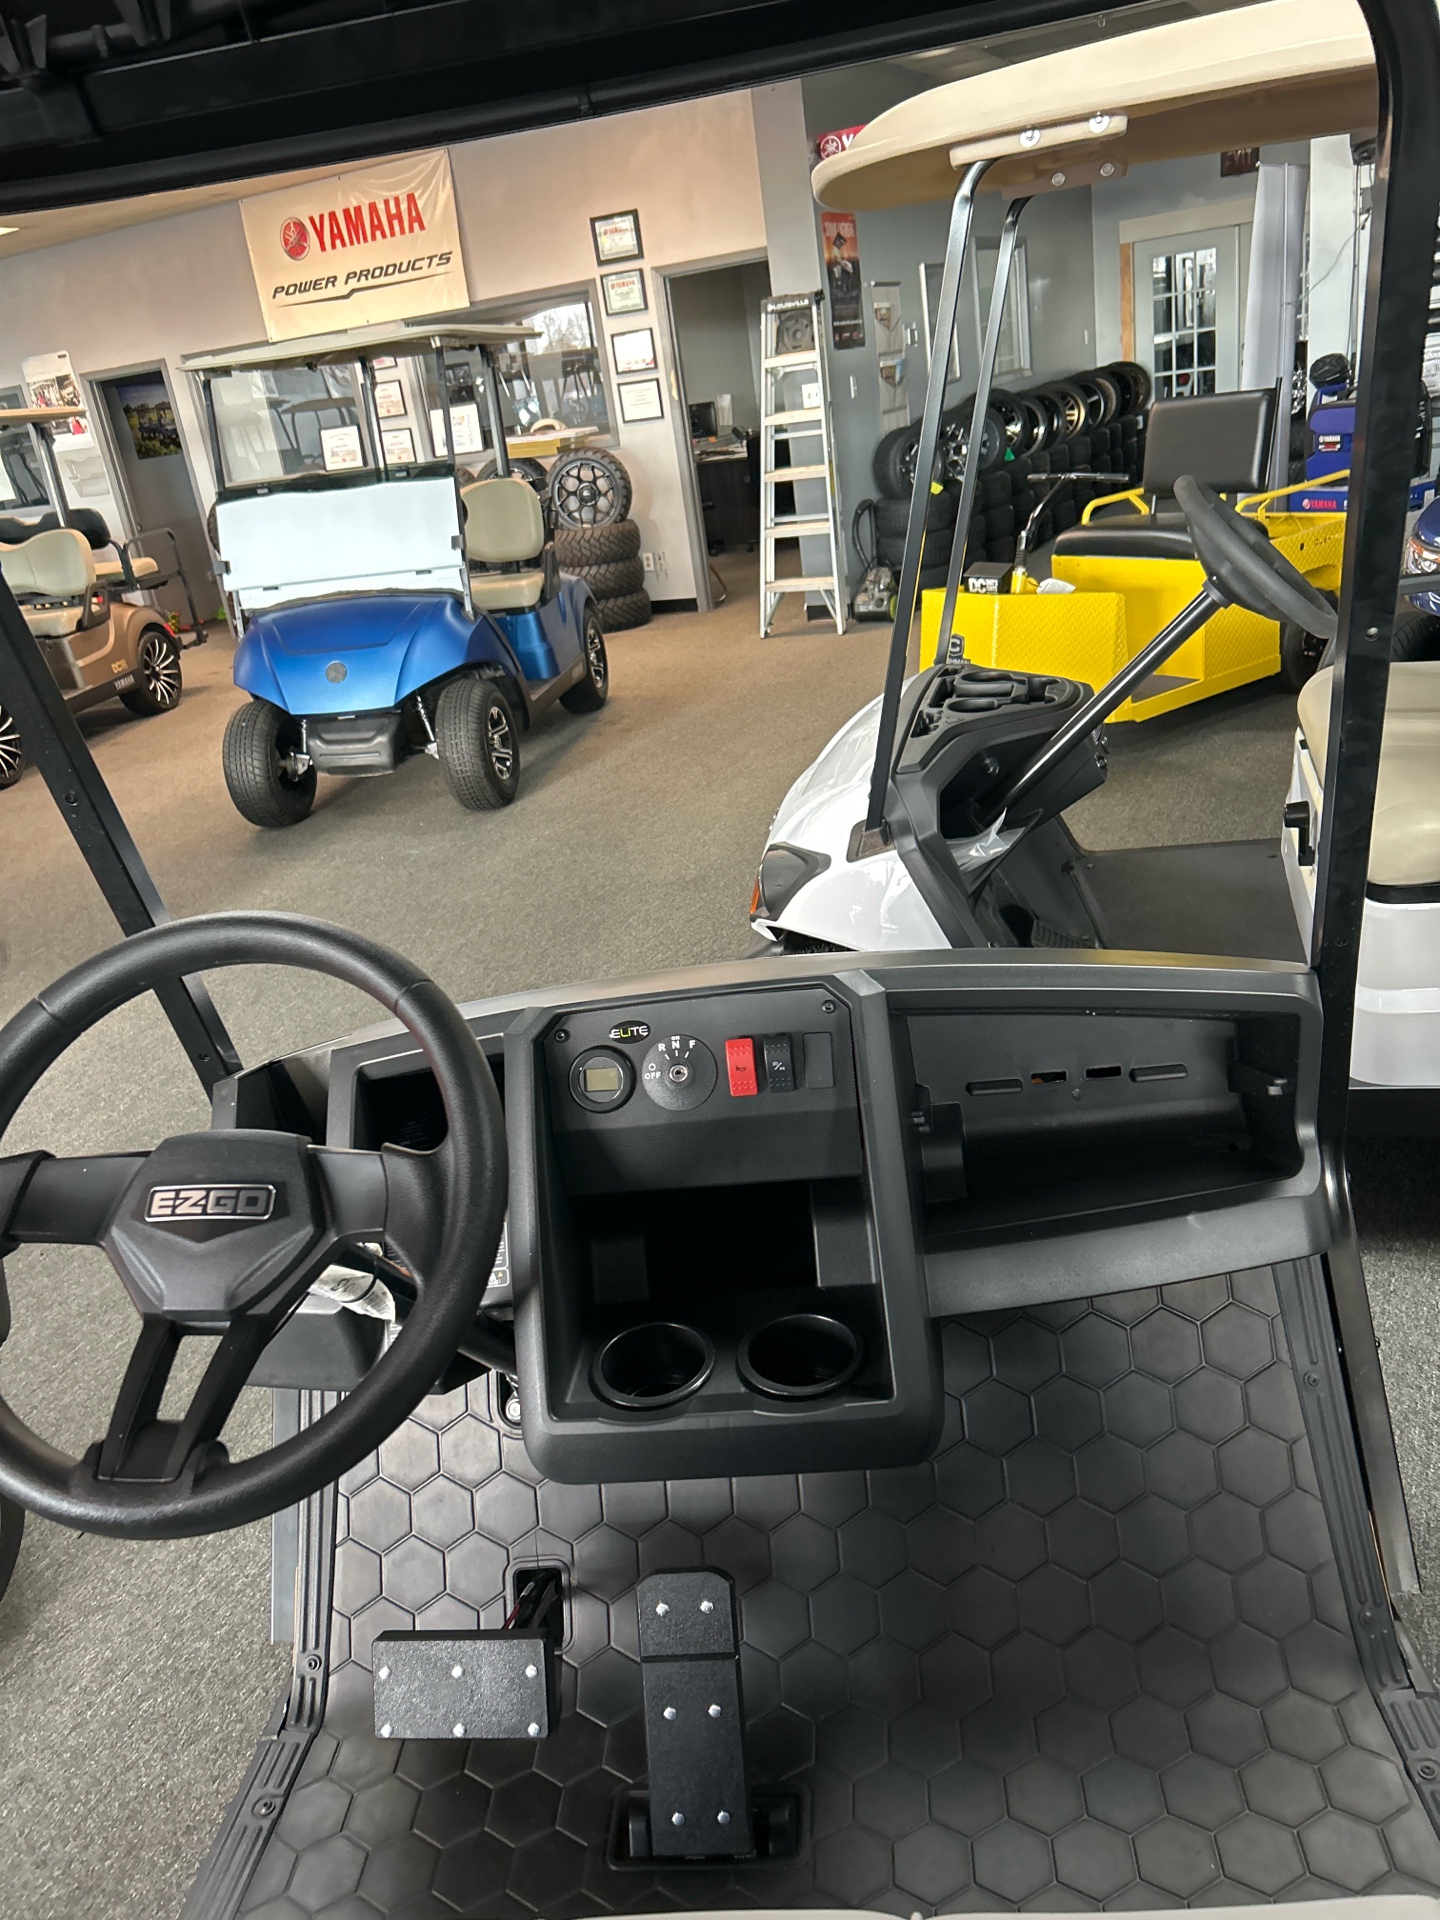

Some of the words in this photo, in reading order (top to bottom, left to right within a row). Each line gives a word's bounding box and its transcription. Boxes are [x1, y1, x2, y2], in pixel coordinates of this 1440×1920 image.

[309, 192, 426, 252] YAMAHA
[272, 275, 338, 299] POWER
[344, 251, 453, 285] PRODUCTS
[1310, 499, 1337, 509] YAMAHA
[968, 577, 987, 594] DC
[114, 674, 135, 691] YAMAHA
[610, 1025, 649, 1039] ELITE
[658, 1043, 667, 1052] R
[671, 1040, 680, 1049] N
[688, 1039, 696, 1049] F
[644, 1071, 662, 1080] OFF
[150, 1189, 268, 1216] EZGO
